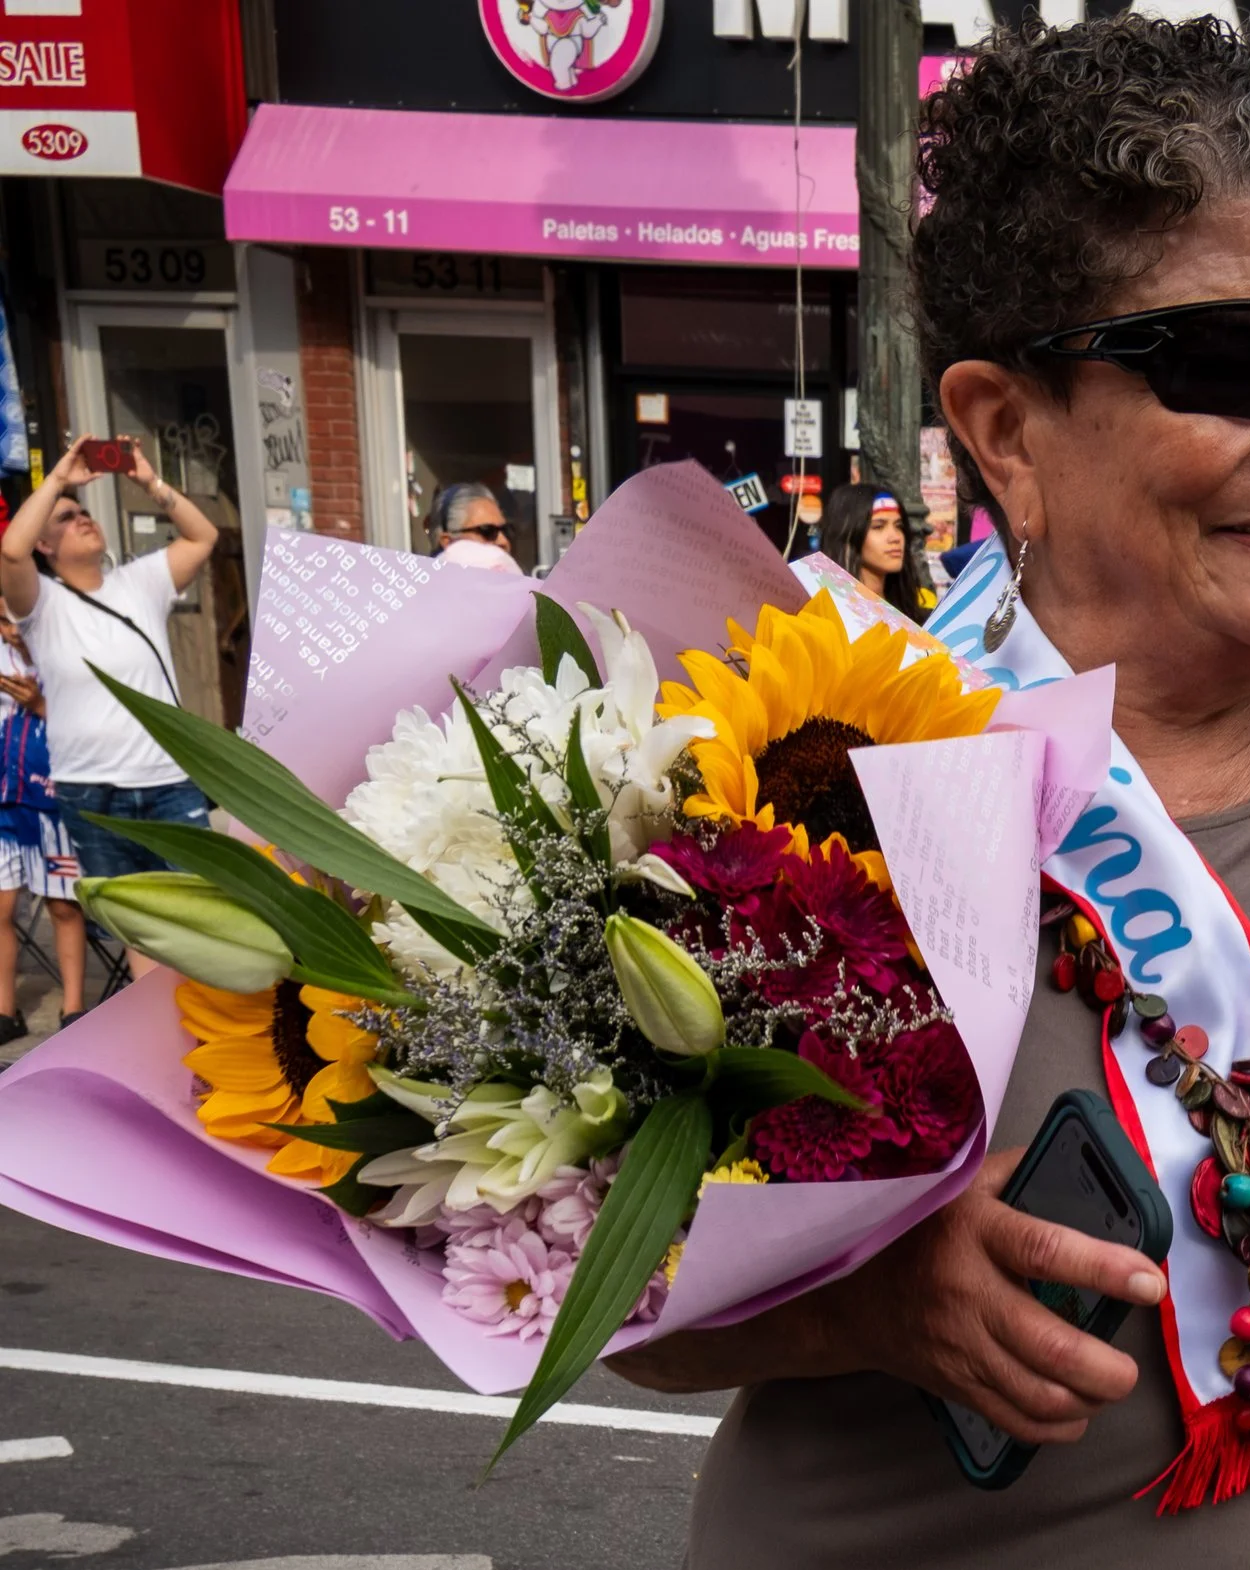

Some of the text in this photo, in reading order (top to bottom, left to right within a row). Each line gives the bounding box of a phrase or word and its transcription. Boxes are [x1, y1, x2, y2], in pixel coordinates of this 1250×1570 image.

[0, 41, 87, 87] SALE
[28, 130, 83, 155] 5309
[329, 206, 359, 233] 53
[383, 209, 409, 235] 11
[543, 218, 619, 243] Paletas
[638, 222, 723, 246] Helados
[740, 226, 808, 252] Aguas
[729, 480, 762, 510] EN
[305, 551, 328, 569] of
[325, 543, 404, 611] ago. But
[330, 570, 359, 598] out
[262, 587, 350, 664] grants and
[364, 600, 389, 625] six
[261, 611, 329, 682] Yes, law
[325, 620, 361, 653] four
